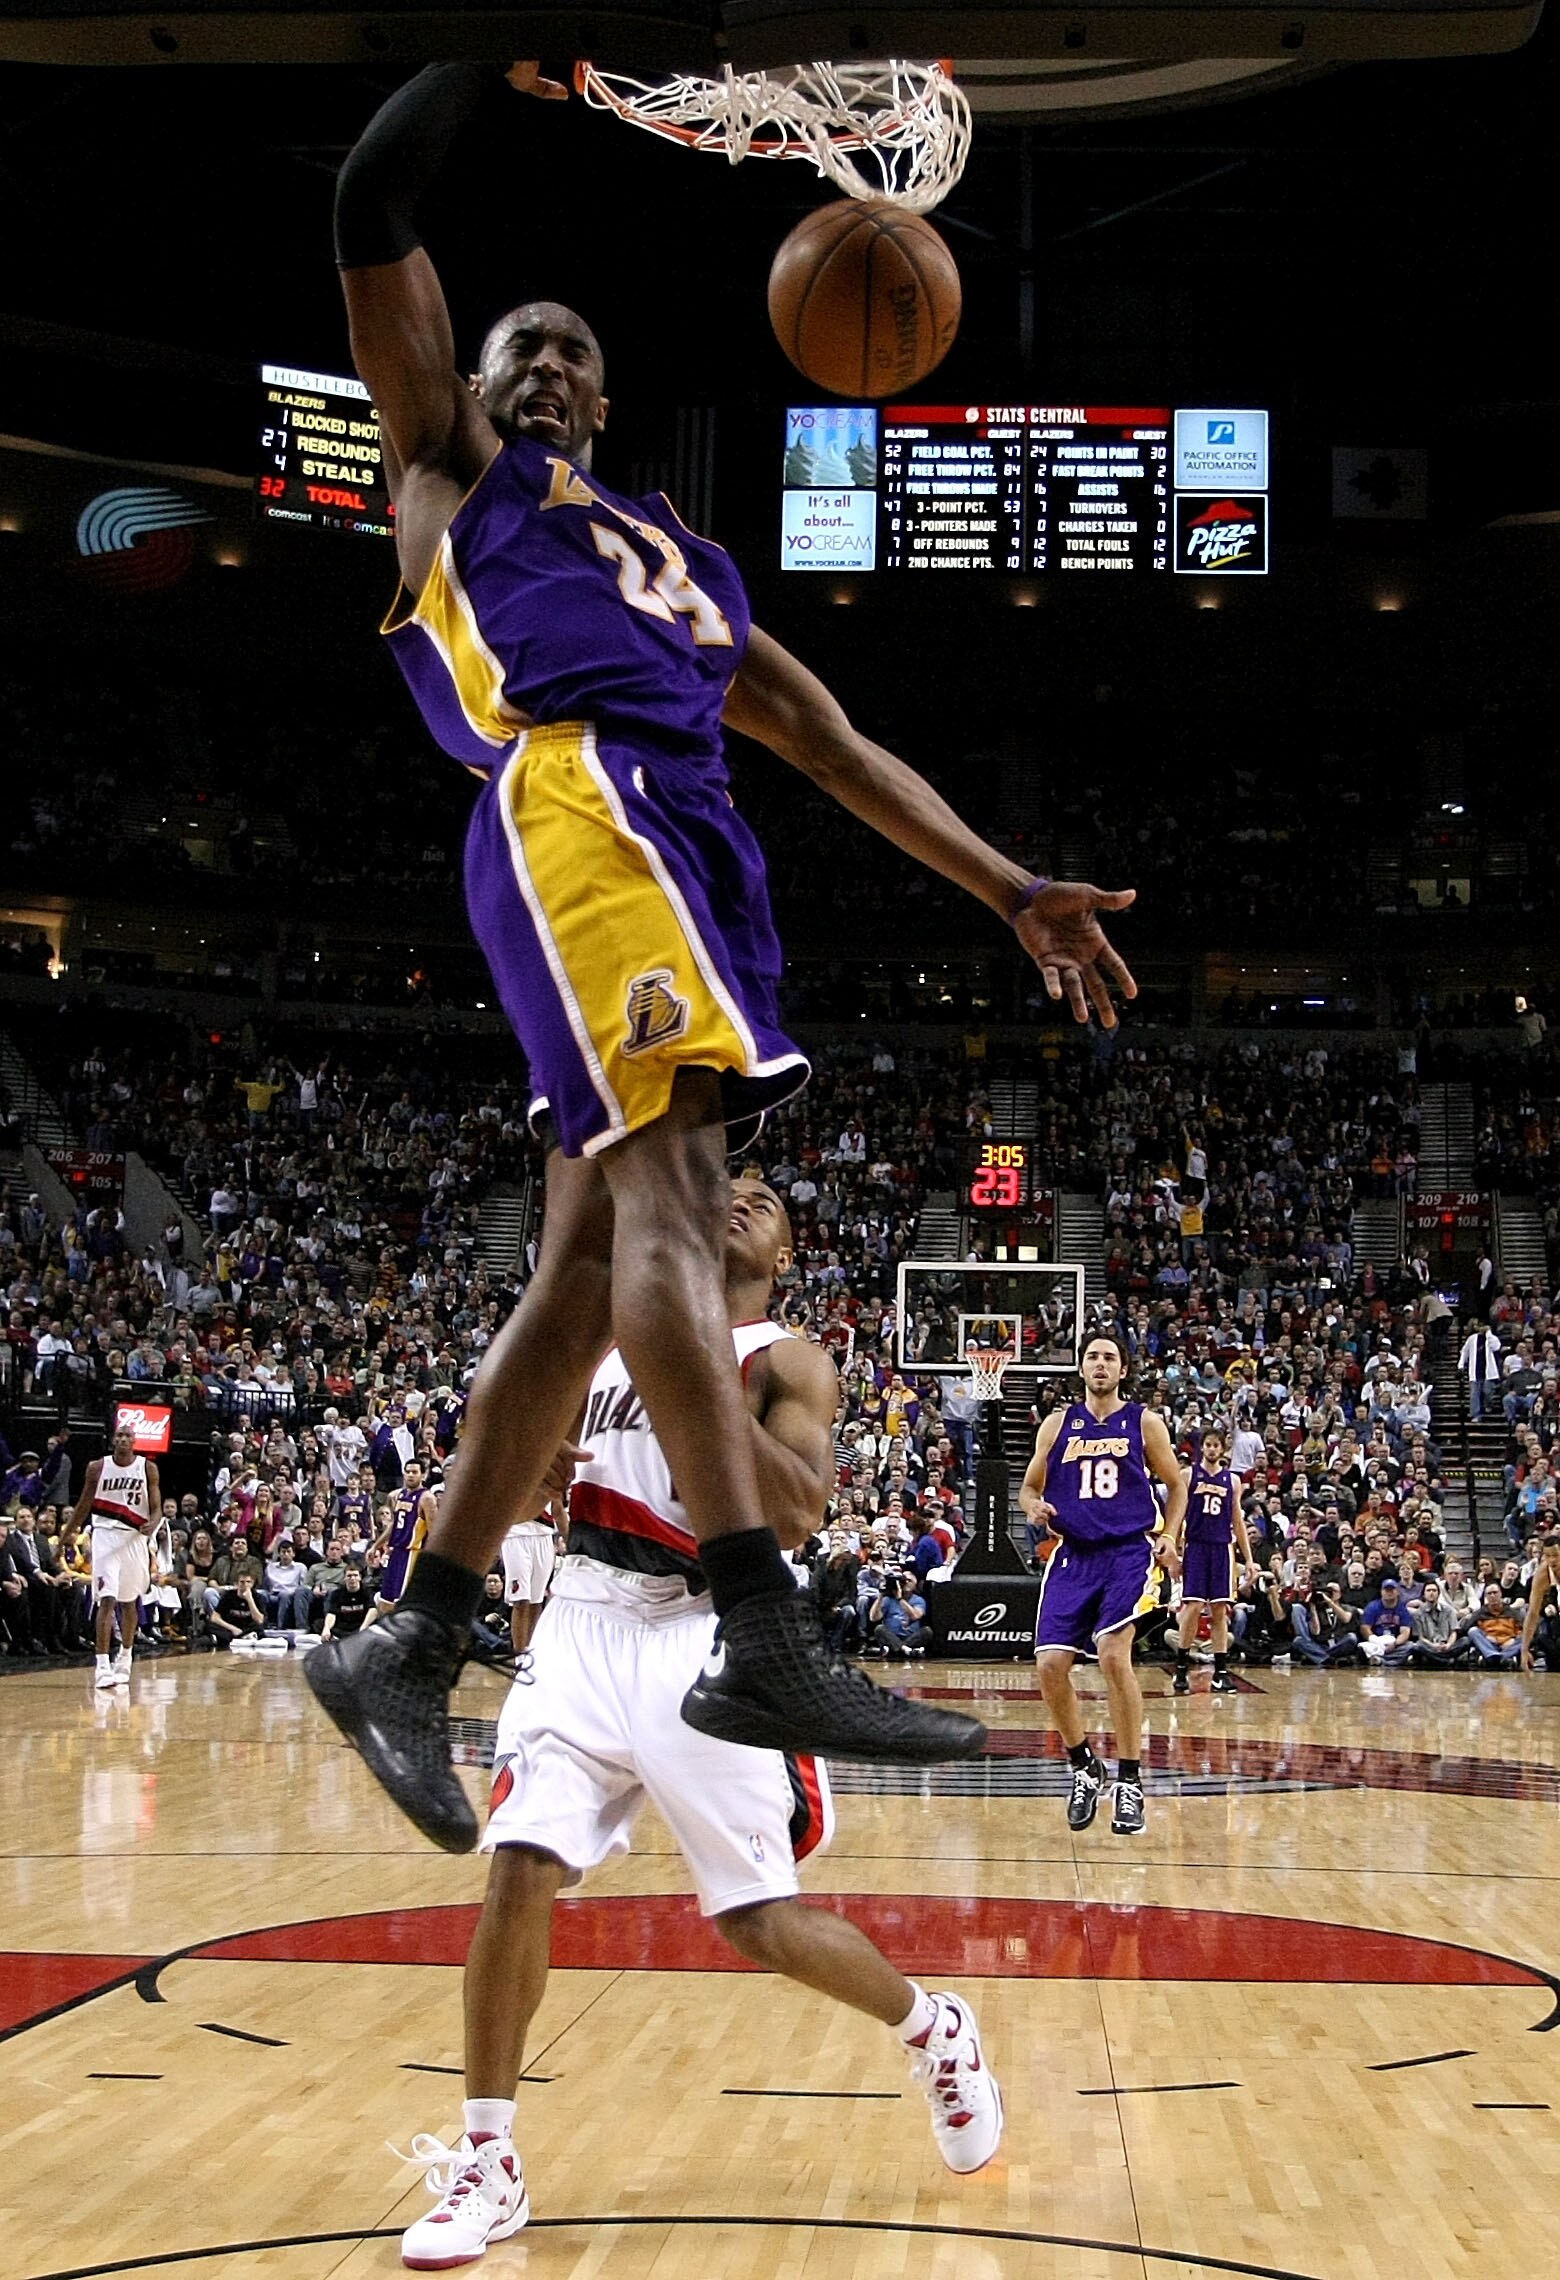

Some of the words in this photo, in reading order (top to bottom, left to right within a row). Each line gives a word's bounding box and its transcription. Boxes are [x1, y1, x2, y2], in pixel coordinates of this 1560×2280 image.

[268, 391, 326, 410] BLAZERS
[282, 409, 288, 424] 1
[987, 407, 1025, 423] STATS
[1030, 408, 1087, 423] CENTRAL
[292, 411, 346, 434] BLOCKED
[349, 422, 381, 440] SHOT
[262, 428, 287, 448] 27
[884, 429, 929, 438] BLAZERS
[297, 436, 381, 463] REBOUNDS
[885, 445, 901, 457] 52
[912, 446, 942, 458] FIELD
[943, 446, 969, 458] GOAL
[971, 446, 994, 459] PCT.
[1004, 446, 1021, 458] 47
[1030, 446, 1047, 458] 24
[1057, 447, 1094, 459] POINTS
[1096, 447, 1107, 459] IN
[1109, 447, 1139, 459] PAINT
[1150, 447, 1167, 460] 30
[1183, 451, 1221, 460] PACIFIC
[1224, 452, 1257, 461] OFFICE
[274, 454, 286, 471] 4
[1186, 461, 1257, 470] AUTOMATION
[302, 460, 374, 485] STEALS
[884, 463, 901, 476] 84
[908, 464, 934, 476] FREE
[936, 464, 972, 477] THROW
[973, 464, 997, 477] PCT.
[1004, 464, 1021, 476] 84
[1037, 464, 1047, 477] 2
[1052, 465, 1076, 477] FAST
[1077, 465, 1108, 477] BREAK
[1109, 465, 1144, 478] POINTS
[1157, 465, 1167, 478] 2
[260, 477, 285, 497] 32
[906, 482, 930, 494] FREE
[931, 482, 970, 495] THROWS
[971, 482, 998, 494] MADE
[1078, 484, 1119, 496] ASSISTS
[306, 485, 366, 509] TOTAL
[808, 495, 830, 508] It's
[834, 495, 851, 508] all
[884, 501, 901, 512] 47
[964, 502, 987, 513] PCT.
[1004, 501, 1021, 513] 53
[1038, 501, 1047, 513] 7
[1069, 503, 1127, 515] TURNOVERS
[1158, 502, 1167, 514] 7
[344, 518, 396, 536] Comcas
[891, 519, 901, 531] 8
[970, 520, 997, 532] MADE
[1012, 519, 1021, 531] 7
[1058, 521, 1104, 533] CHARGES
[1106, 521, 1137, 533] TAKEN
[786, 535, 872, 551] YOCREAM
[893, 537, 901, 549] 7
[913, 539, 933, 550] OFF
[935, 539, 989, 550] REBOUNDS
[1011, 538, 1020, 549] 9
[1033, 538, 1047, 550] 12
[1066, 539, 1096, 551] TOTAL
[1097, 539, 1130, 551] FOULS
[1153, 539, 1167, 551] 12
[1200, 537, 1250, 563] Hut
[908, 557, 929, 569] 2ND
[930, 557, 971, 569] CHANCE
[973, 557, 995, 569] PTS.
[1007, 557, 1020, 568] 10
[1033, 557, 1047, 569] 12
[1061, 558, 1096, 570] BENCH
[1097, 558, 1133, 570] POINTS
[1153, 557, 1166, 570] 12
[590, 521, 733, 646] 24
[48, 1149, 73, 1161] 206
[88, 1152, 112, 1165] 207
[981, 1144, 1024, 1168] 3:05
[971, 1167, 1019, 1206] 23
[1417, 1194, 1442, 1206] 209
[1456, 1193, 1479, 1205] 210
[1418, 1216, 1439, 1228] 107
[1457, 1216, 1478, 1228] 108
[585, 1384, 653, 1441] BLAZ
[117, 1408, 170, 1433] Bud
[103, 1478, 143, 1491] BLAZERS
[1079, 1459, 1118, 1499] 18
[1202, 1495, 1222, 1515] 16
[397, 1510, 406, 1528] 5
[947, 1630, 1033, 1642] NAUTILUS
